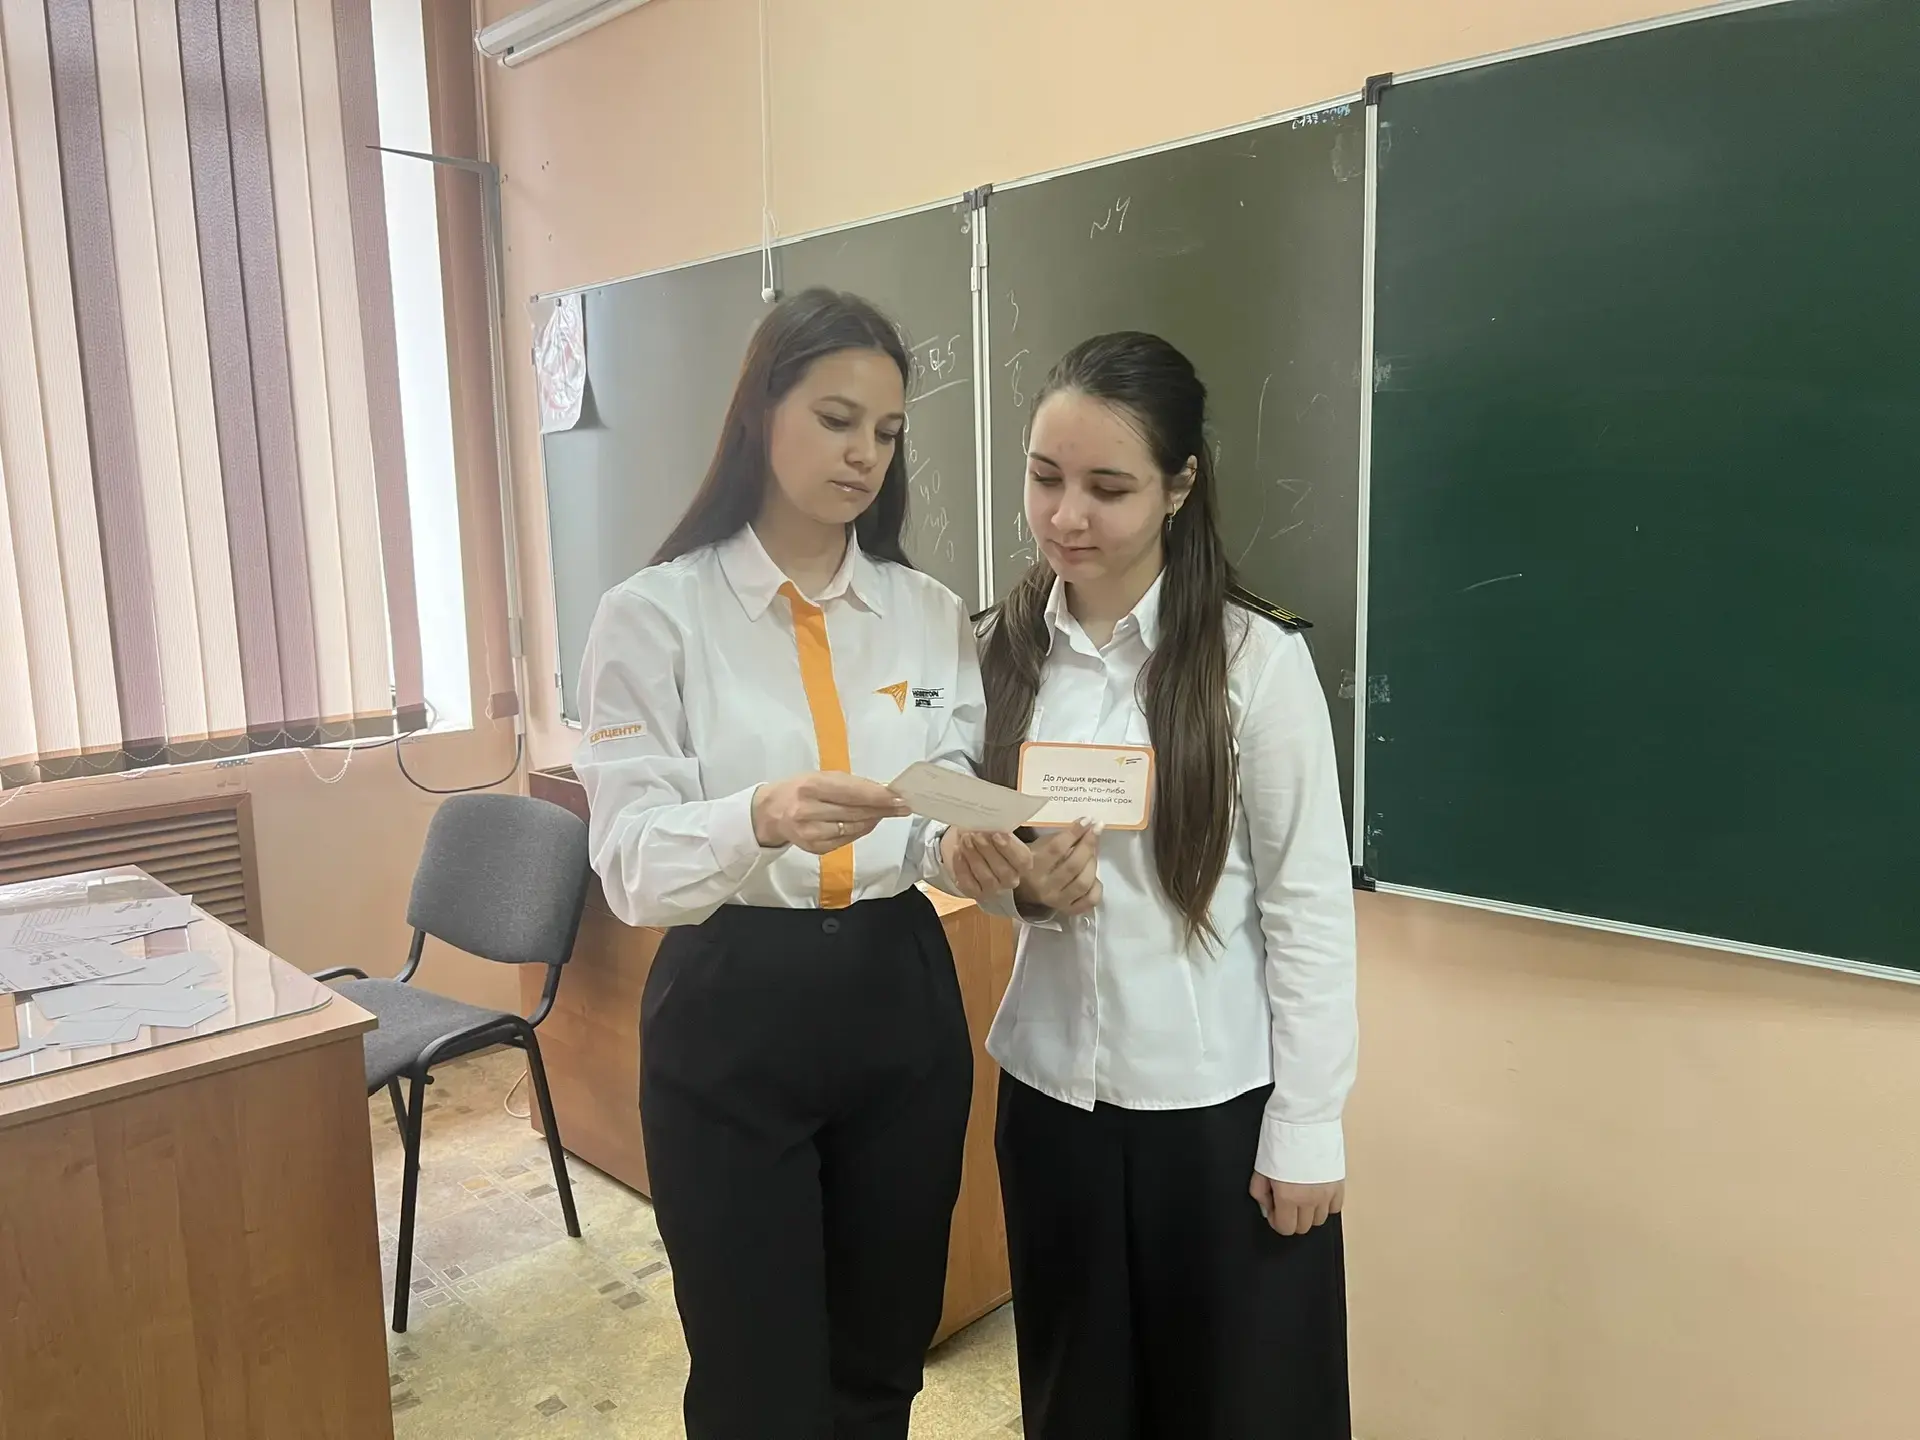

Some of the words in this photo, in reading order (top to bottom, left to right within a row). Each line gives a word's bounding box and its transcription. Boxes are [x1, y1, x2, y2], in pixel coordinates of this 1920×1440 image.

[1043, 774, 1055, 782] До
[1056, 776, 1086, 784] лучших
[1087, 776, 1117, 784] времен
[1050, 785, 1087, 793] отложить
[1089, 787, 1126, 795] что-либо
[1048, 795, 1112, 804] еопределённый
